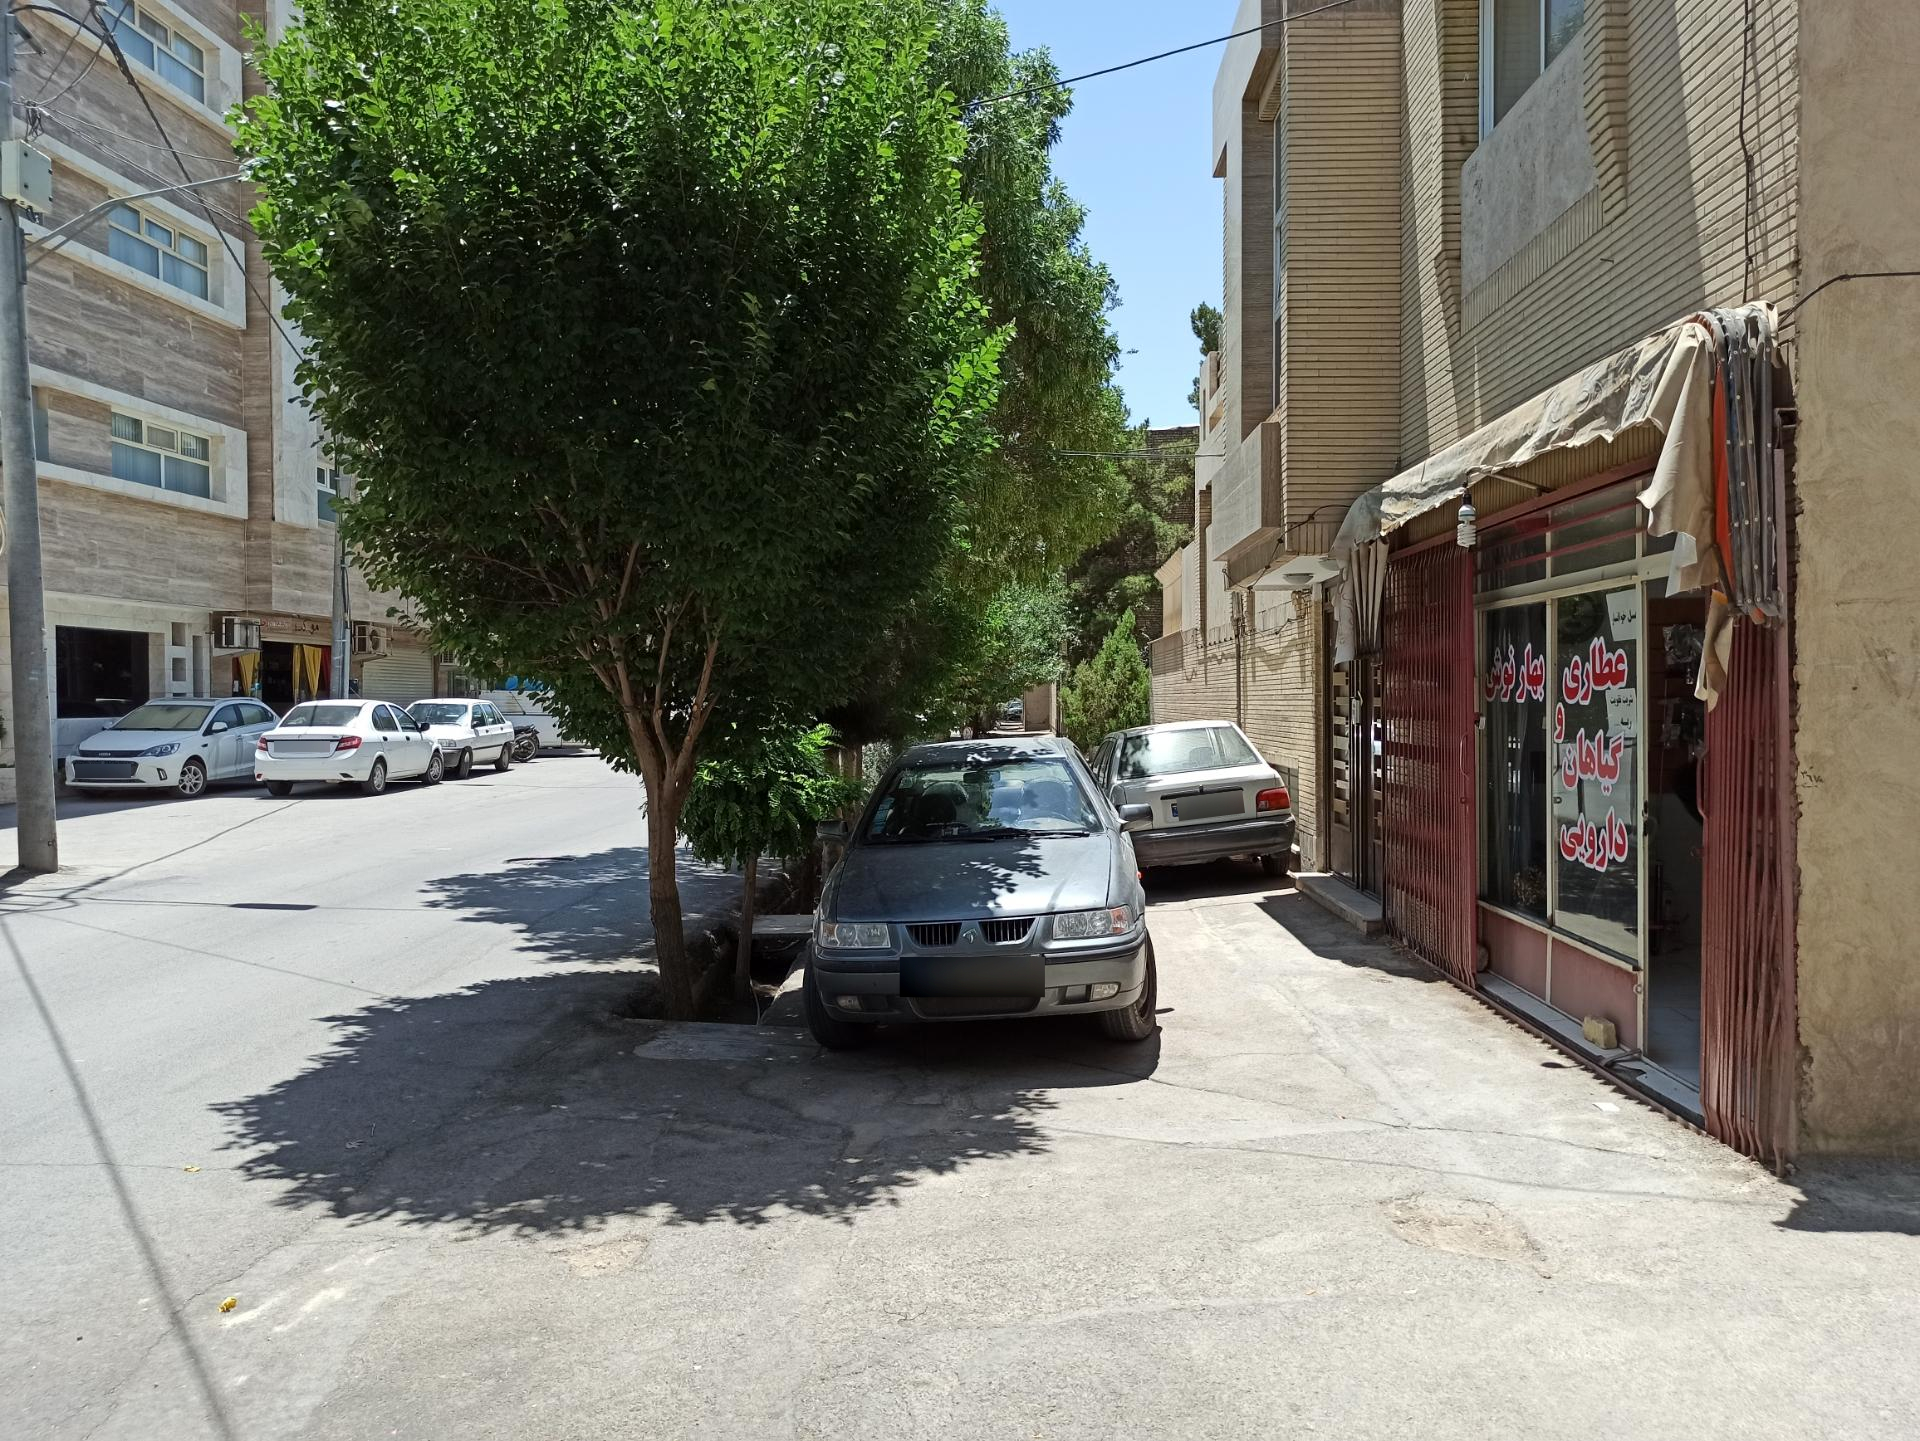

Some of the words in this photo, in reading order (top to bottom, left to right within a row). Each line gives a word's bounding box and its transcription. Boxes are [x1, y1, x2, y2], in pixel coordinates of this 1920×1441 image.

[1563, 636, 1629, 706] عطاری
[1554, 702, 1566, 744] و
[1561, 728, 1625, 796] گیاهان
[1560, 806, 1628, 872] دارویی
